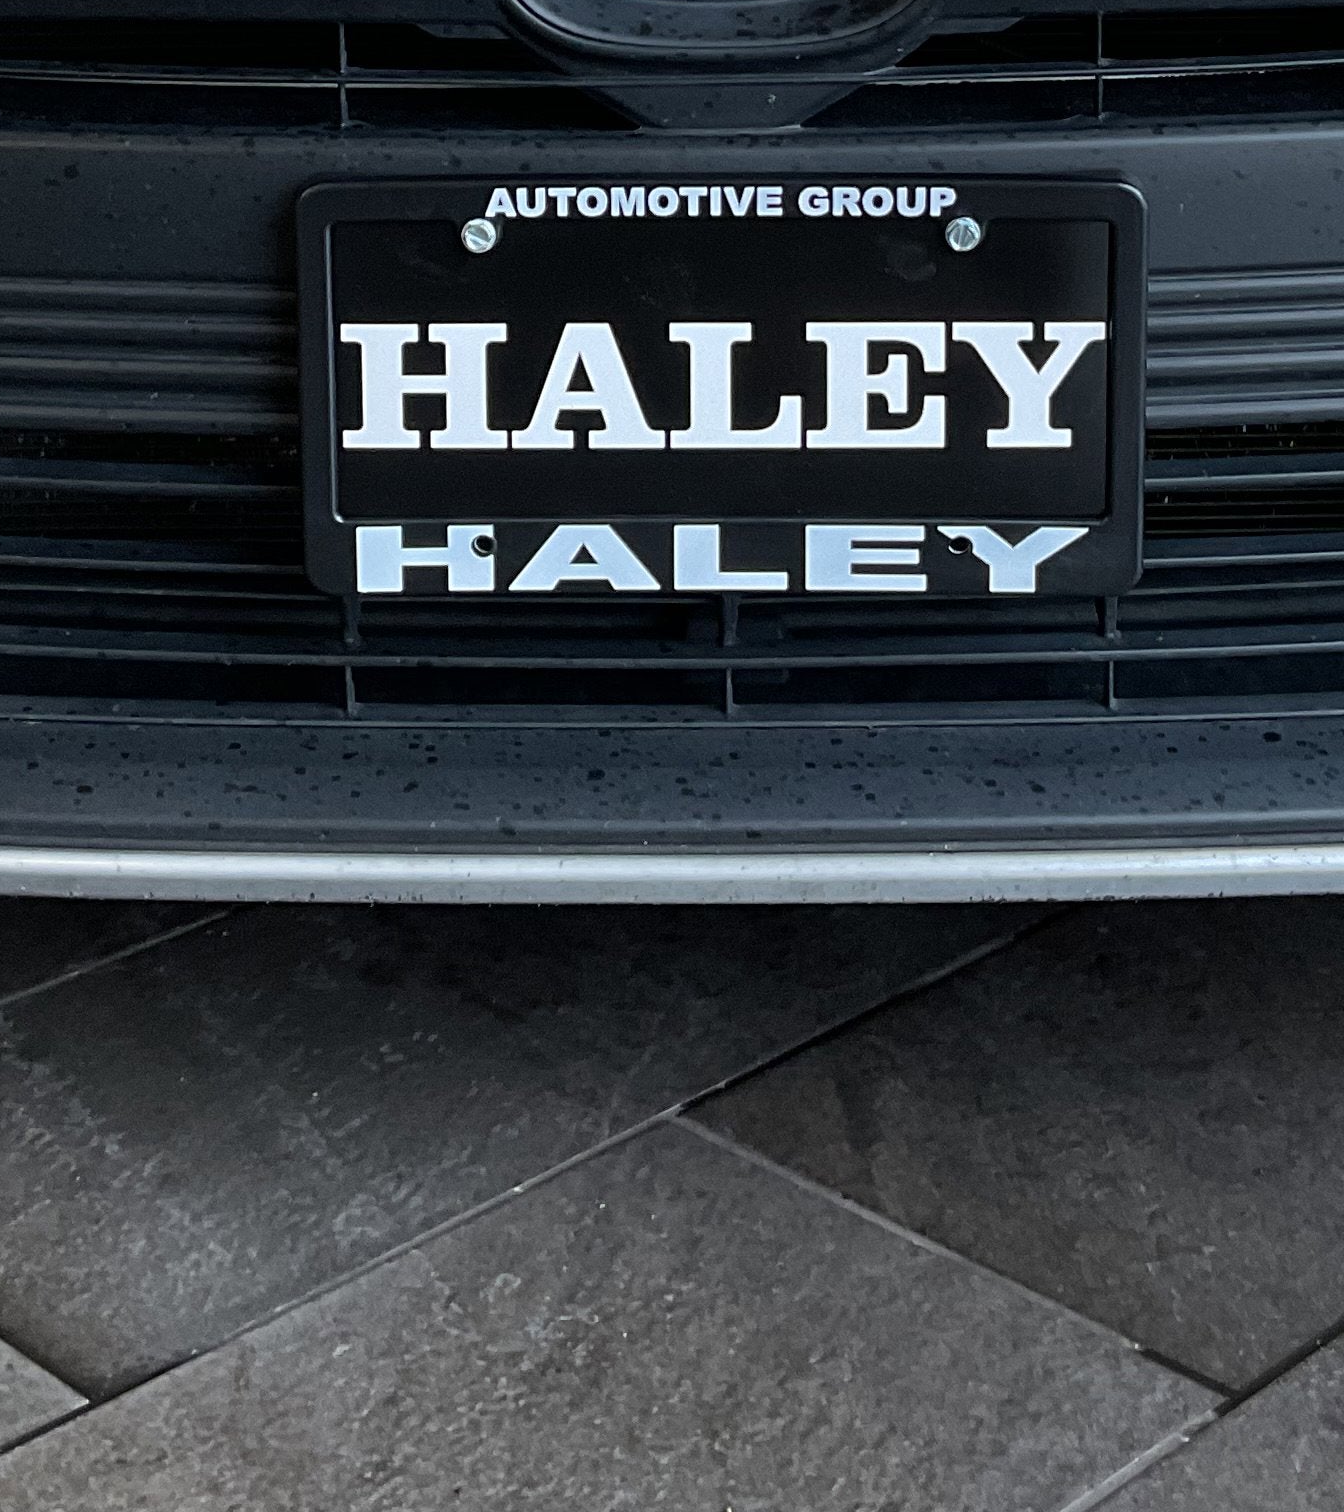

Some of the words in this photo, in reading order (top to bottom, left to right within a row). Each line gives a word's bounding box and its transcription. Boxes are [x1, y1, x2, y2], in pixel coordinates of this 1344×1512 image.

[484, 185, 784, 219] AUTOMOTIVE
[797, 185, 958, 219] GROUP
[338, 320, 1107, 450] HALEY
[354, 522, 1091, 594] HALEY
